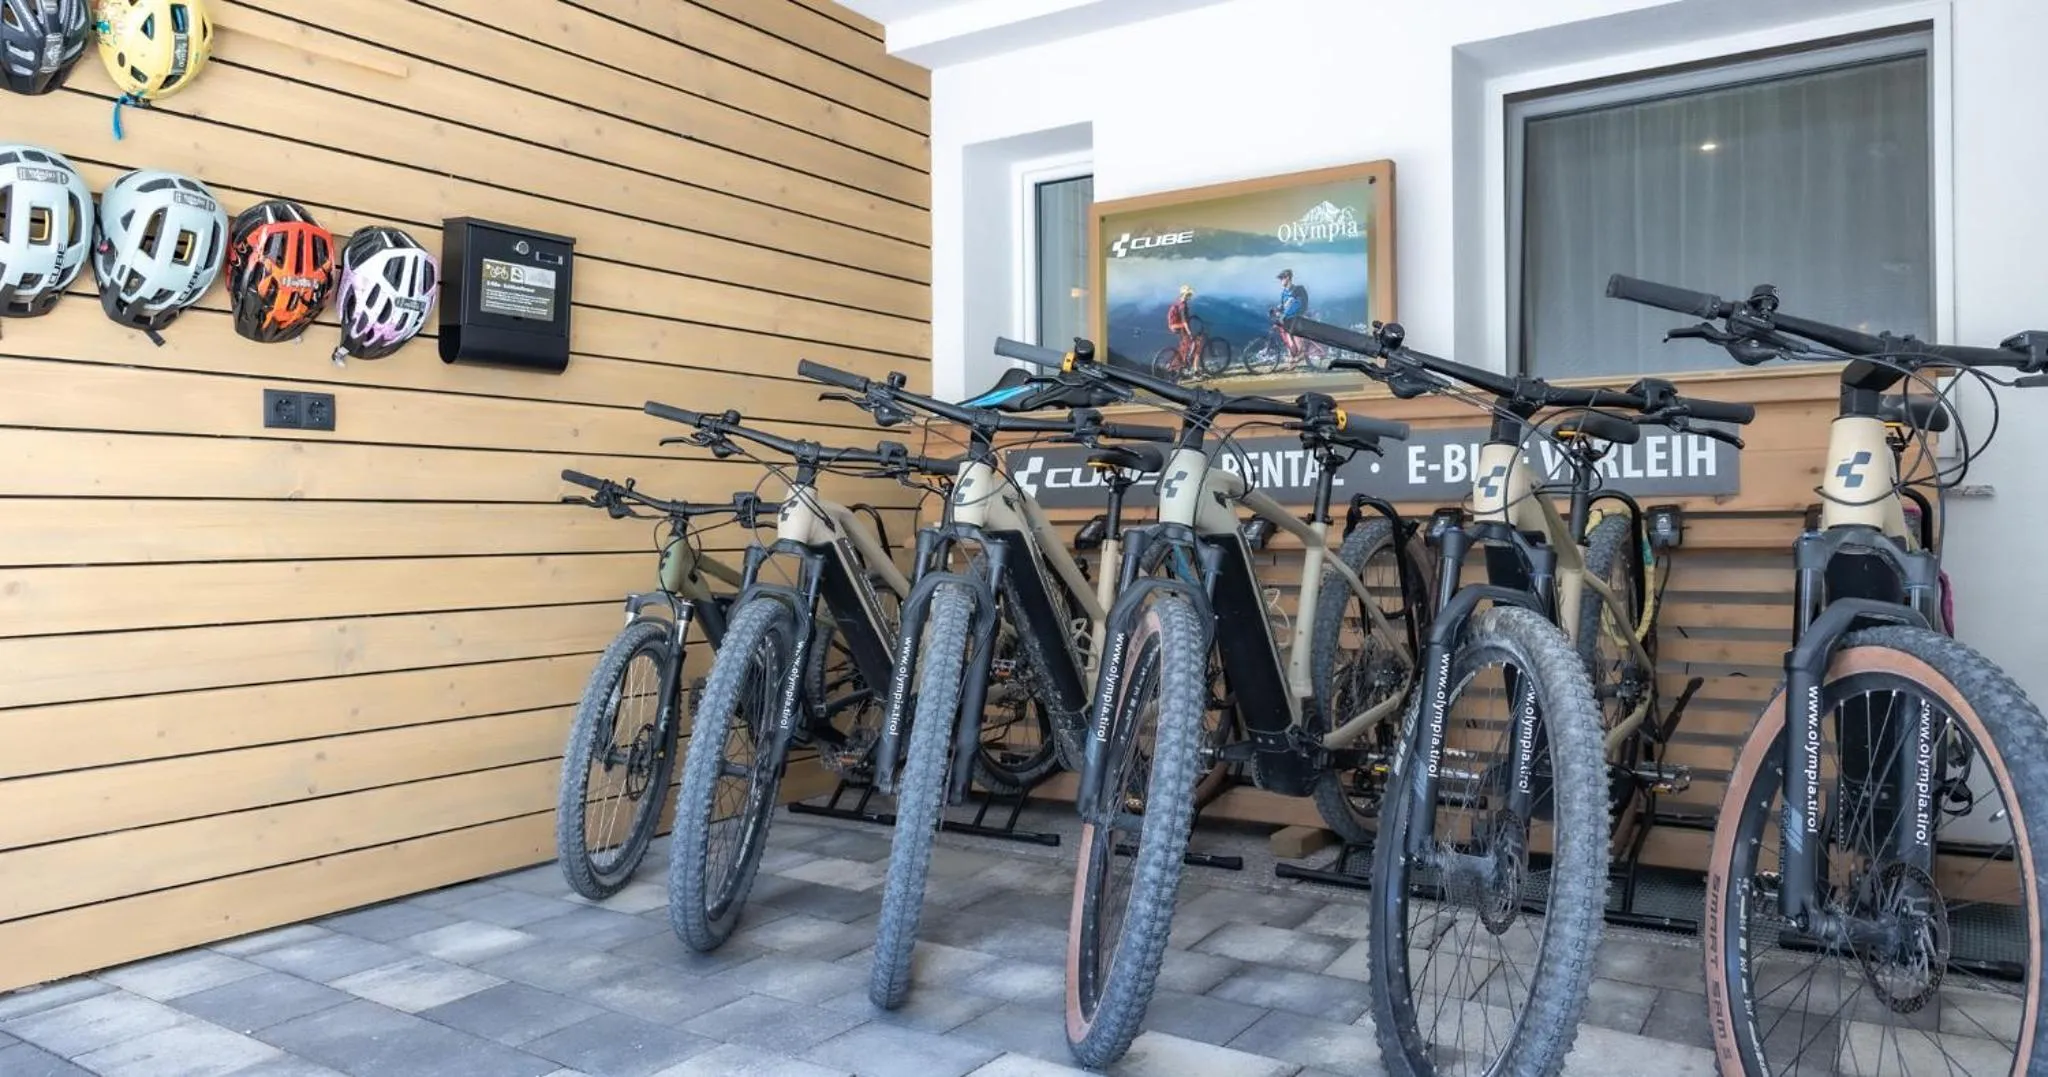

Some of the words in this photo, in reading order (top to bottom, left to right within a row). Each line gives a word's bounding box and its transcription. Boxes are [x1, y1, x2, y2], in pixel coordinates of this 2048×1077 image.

[49, 242, 66, 285] CUBE
[1130, 231, 1194, 249] CUBE
[1278, 220, 1358, 247] Olympia
[1408, 441, 1530, 484] E-BI
[1539, 434, 1717, 480] VRLEIH
[888, 637, 914, 736] www.olympia.tirol
[1095, 632, 1126, 743] www.olympia.tirol
[1427, 653, 1450, 778] www.olympia.tirol
[1806, 685, 1821, 833] www.olympia.tirol
